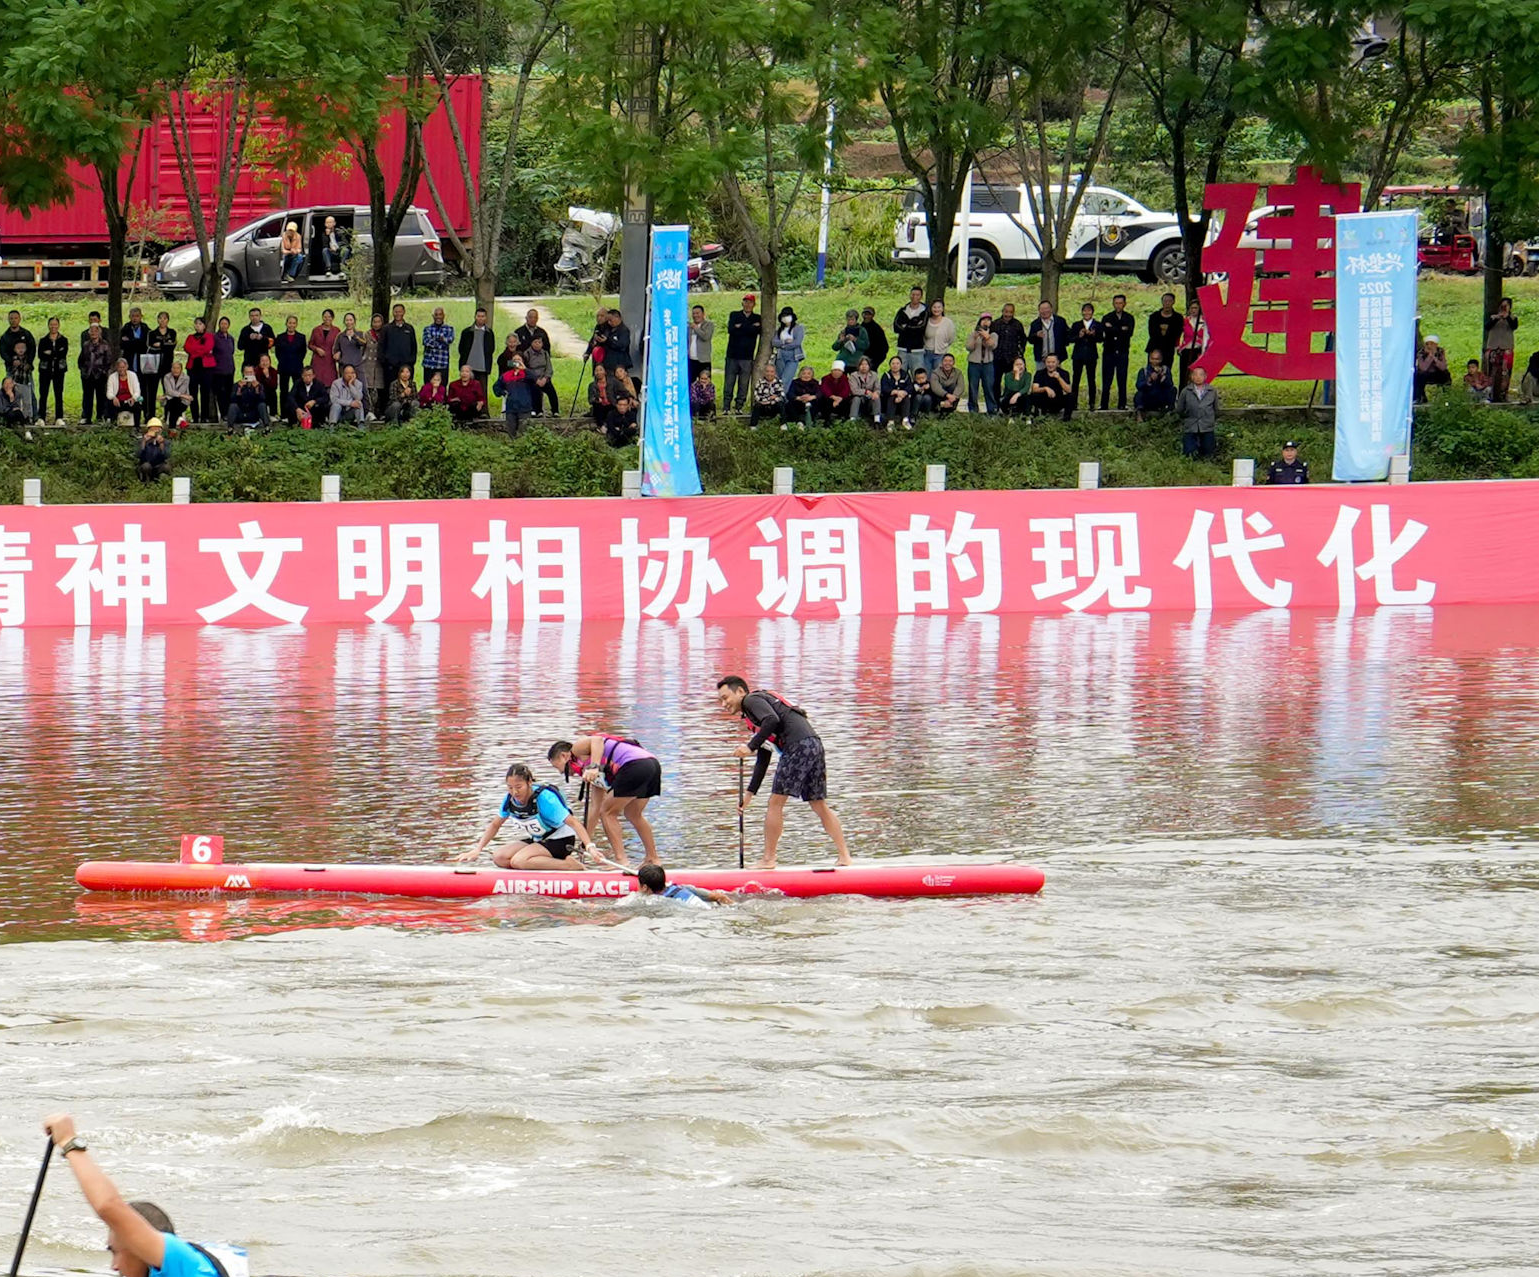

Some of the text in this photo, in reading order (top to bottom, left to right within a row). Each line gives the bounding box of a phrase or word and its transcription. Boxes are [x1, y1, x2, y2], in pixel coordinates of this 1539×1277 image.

[1195, 166, 1362, 383] 建
[191, 836, 212, 863] 6
[493, 879, 631, 896] AIRSHIP RACE
